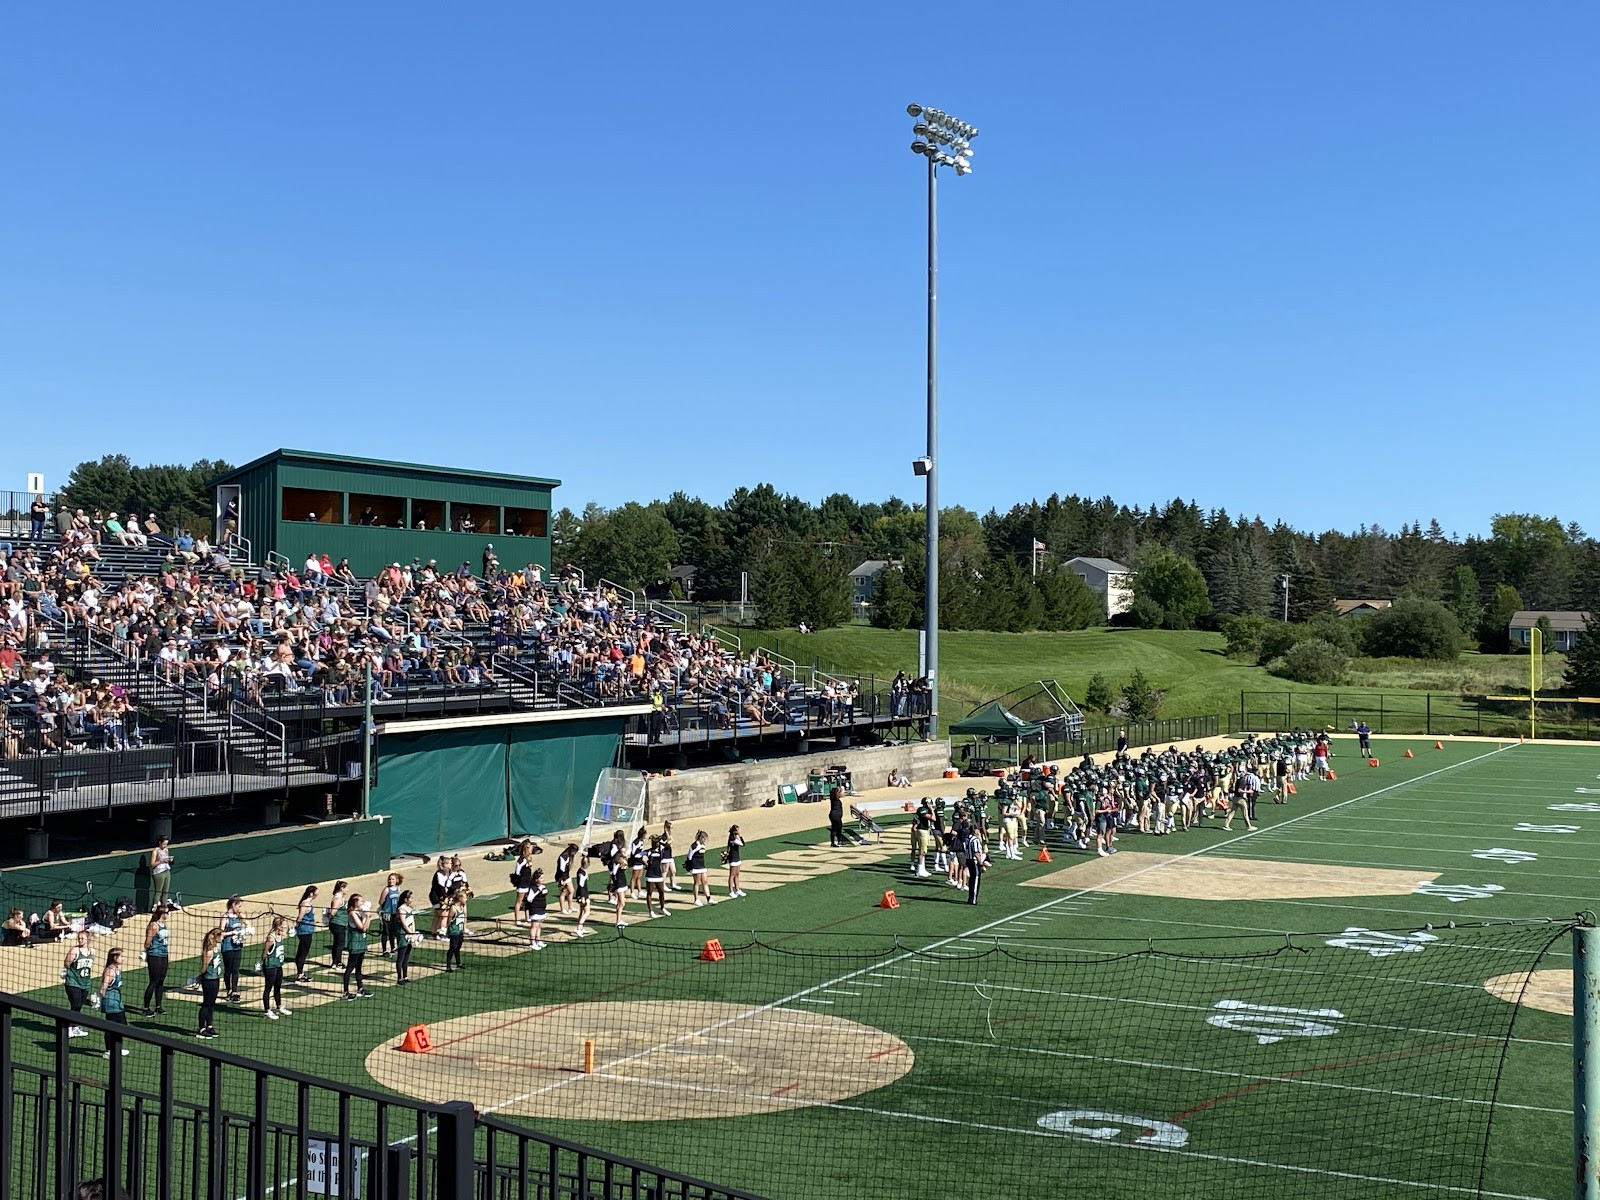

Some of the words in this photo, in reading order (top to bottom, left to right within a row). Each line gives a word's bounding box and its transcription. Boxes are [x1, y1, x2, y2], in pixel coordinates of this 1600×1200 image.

[710, 941, 724, 958] 10
[1325, 926, 1439, 953] 20
[1206, 999, 1345, 1037] 10
[414, 1029, 430, 1050] G
